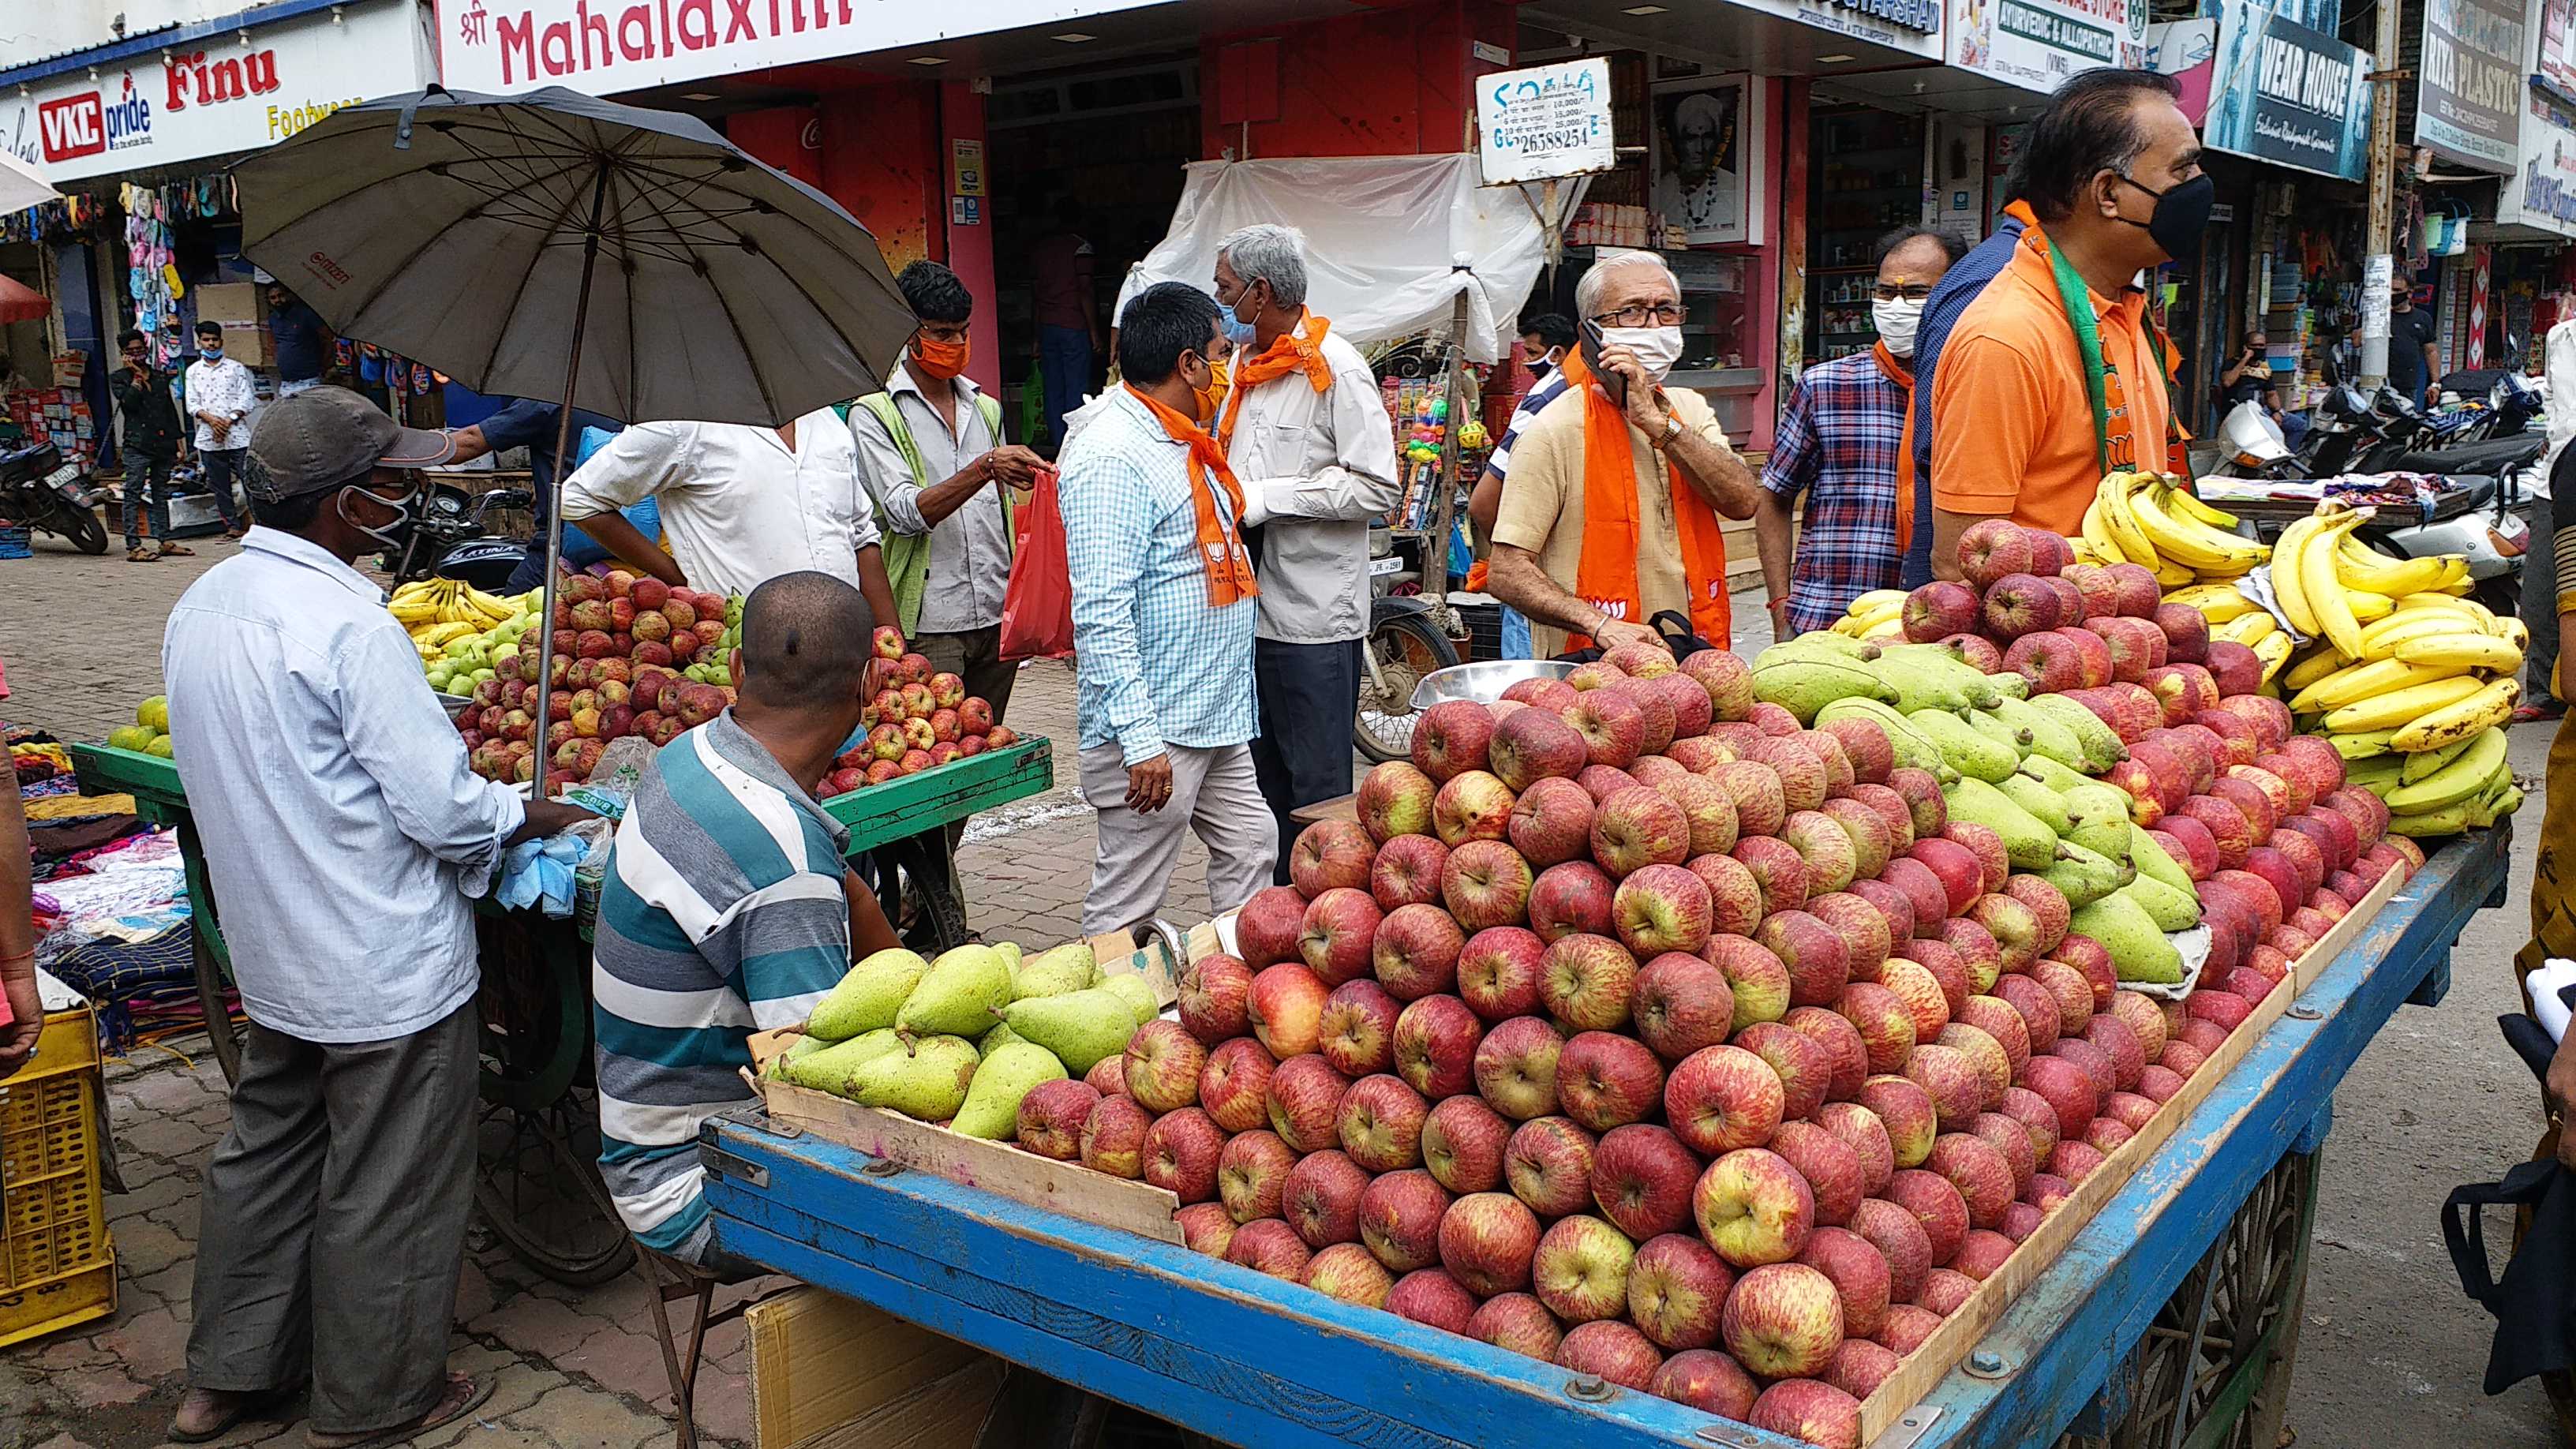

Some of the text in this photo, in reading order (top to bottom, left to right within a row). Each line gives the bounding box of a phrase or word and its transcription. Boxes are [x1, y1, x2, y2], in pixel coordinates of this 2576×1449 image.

[1999, 8, 2051, 39] AYURVEDIC
[2054, 22, 2061, 43] &
[2061, 21, 2114, 59] ALLOPATHIC
[164, 49, 282, 112] Finu
[2258, 34, 2349, 118] WEAR HOUSE
[2426, 31, 2456, 95] RIYA
[2457, 51, 2519, 118] PLASTIC
[42, 100, 100, 152] VKC
[105, 85, 152, 151] pride
[266, 97, 363, 140] Footw
